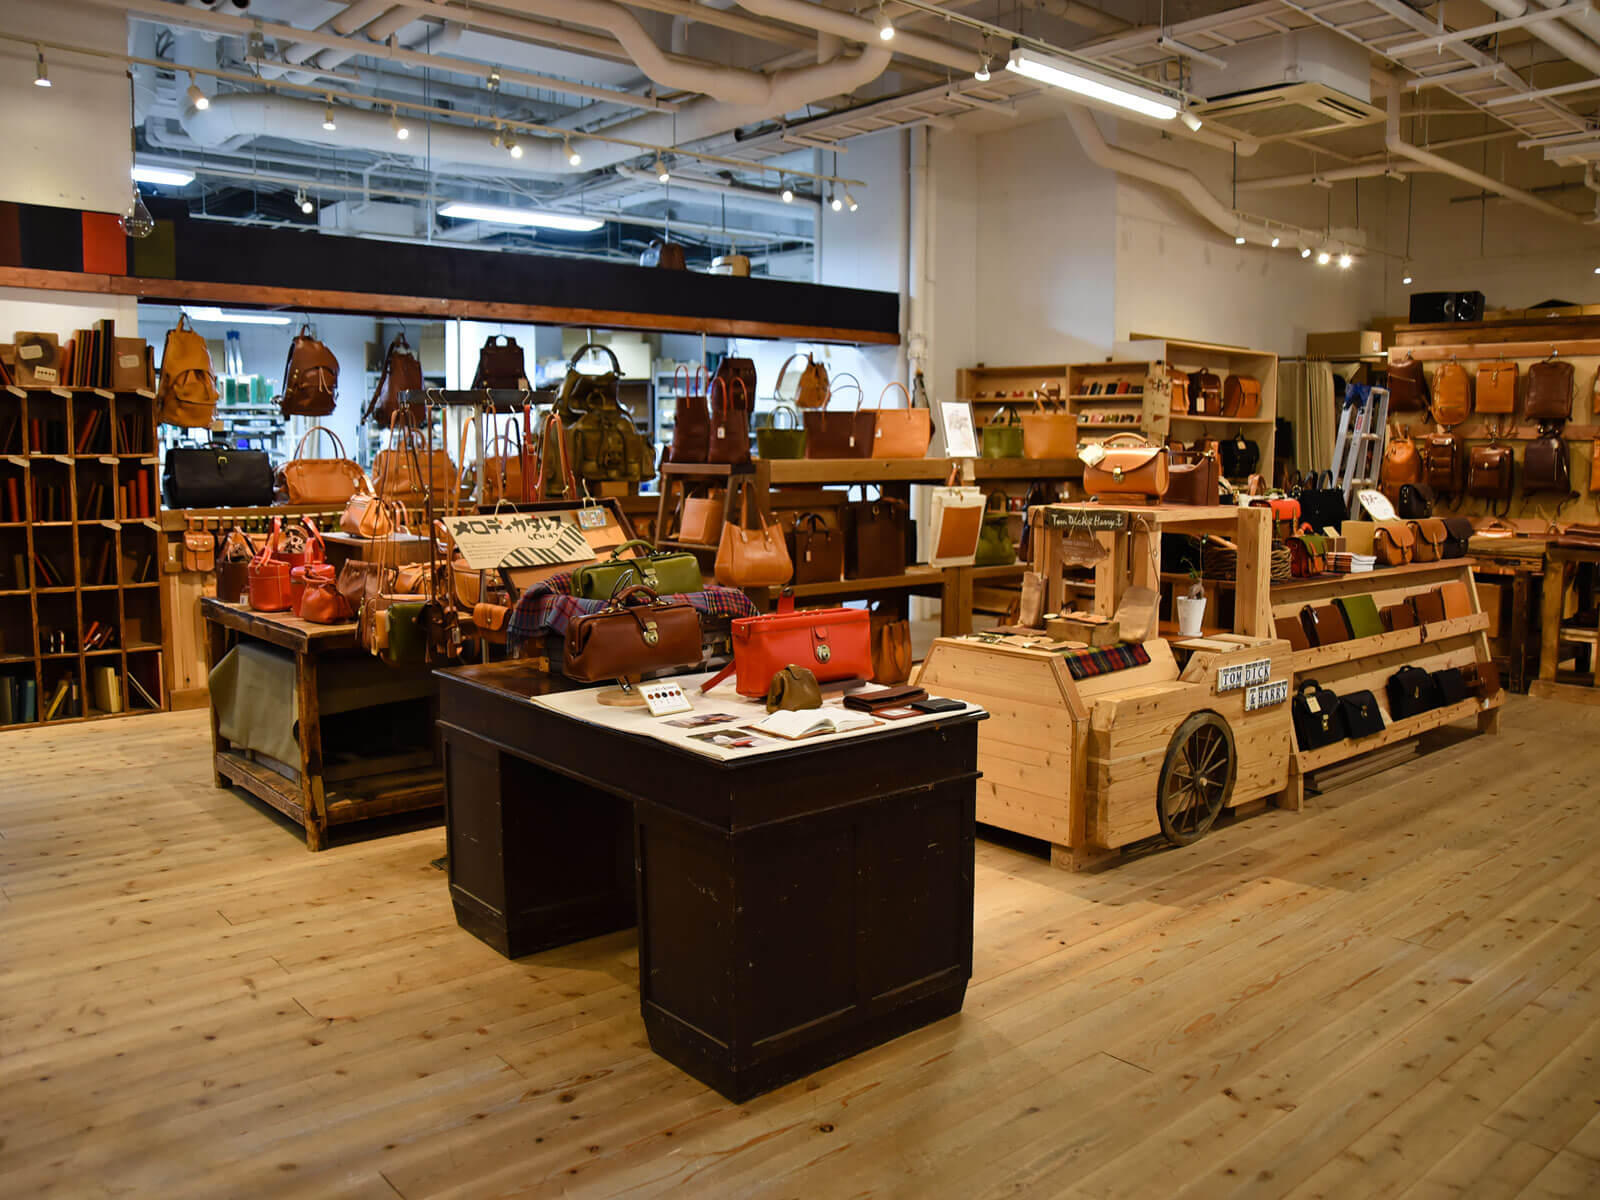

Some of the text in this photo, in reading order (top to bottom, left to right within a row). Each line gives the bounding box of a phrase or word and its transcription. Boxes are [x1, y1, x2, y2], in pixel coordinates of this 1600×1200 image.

[1051, 514, 1067, 526] Tom
[1068, 514, 1087, 526] Dick
[1094, 514, 1115, 529] Harry
[1223, 667, 1270, 685] TOM DICK
[1250, 687, 1287, 705] & HARRY
